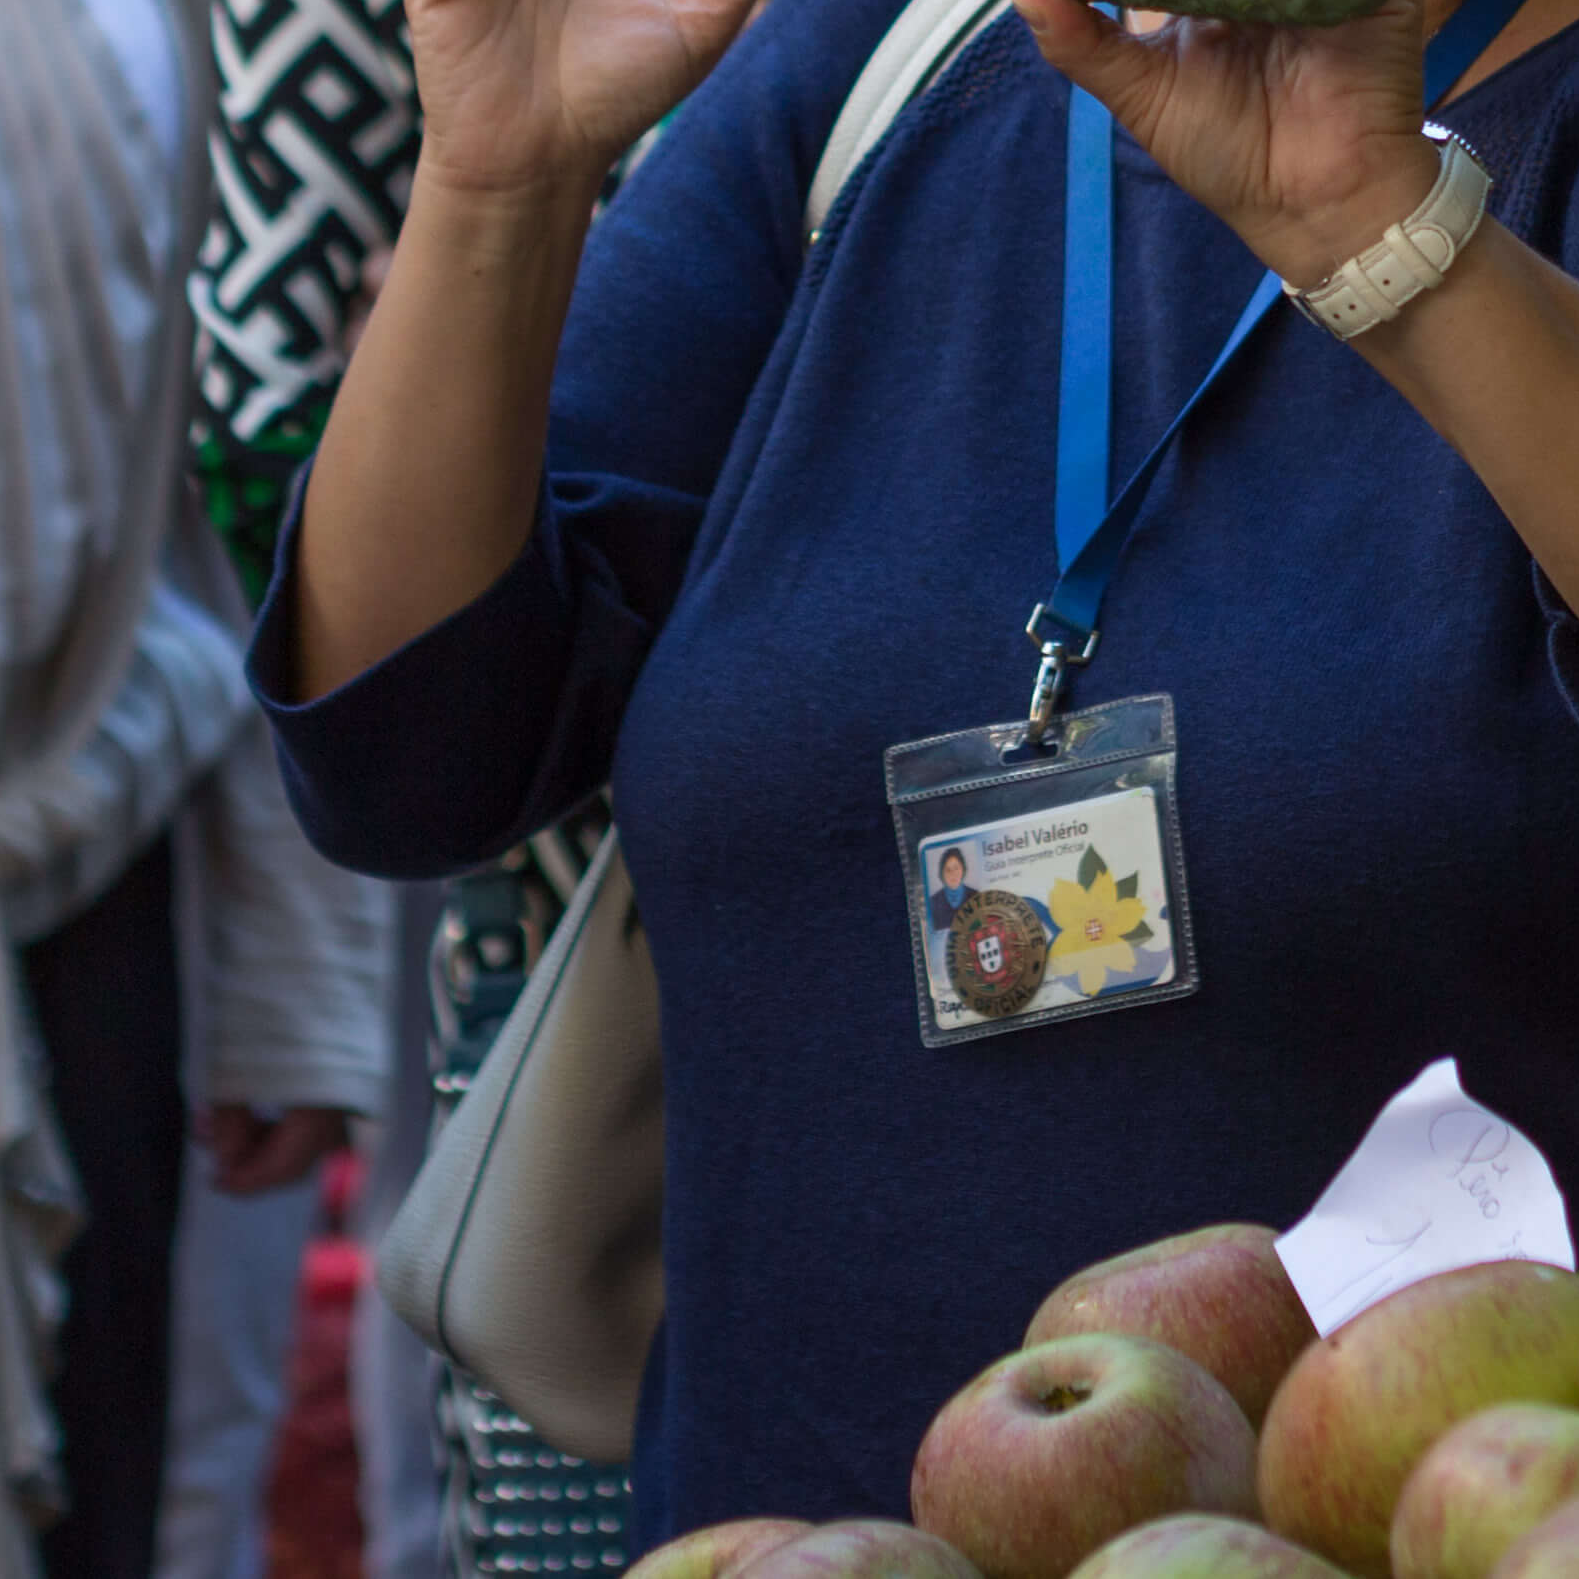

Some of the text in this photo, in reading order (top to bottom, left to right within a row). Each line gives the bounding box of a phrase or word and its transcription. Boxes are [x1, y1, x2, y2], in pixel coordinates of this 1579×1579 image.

[982, 820, 1089, 856] Isabel Valério
[956, 890, 1045, 949] INTERPRETE
